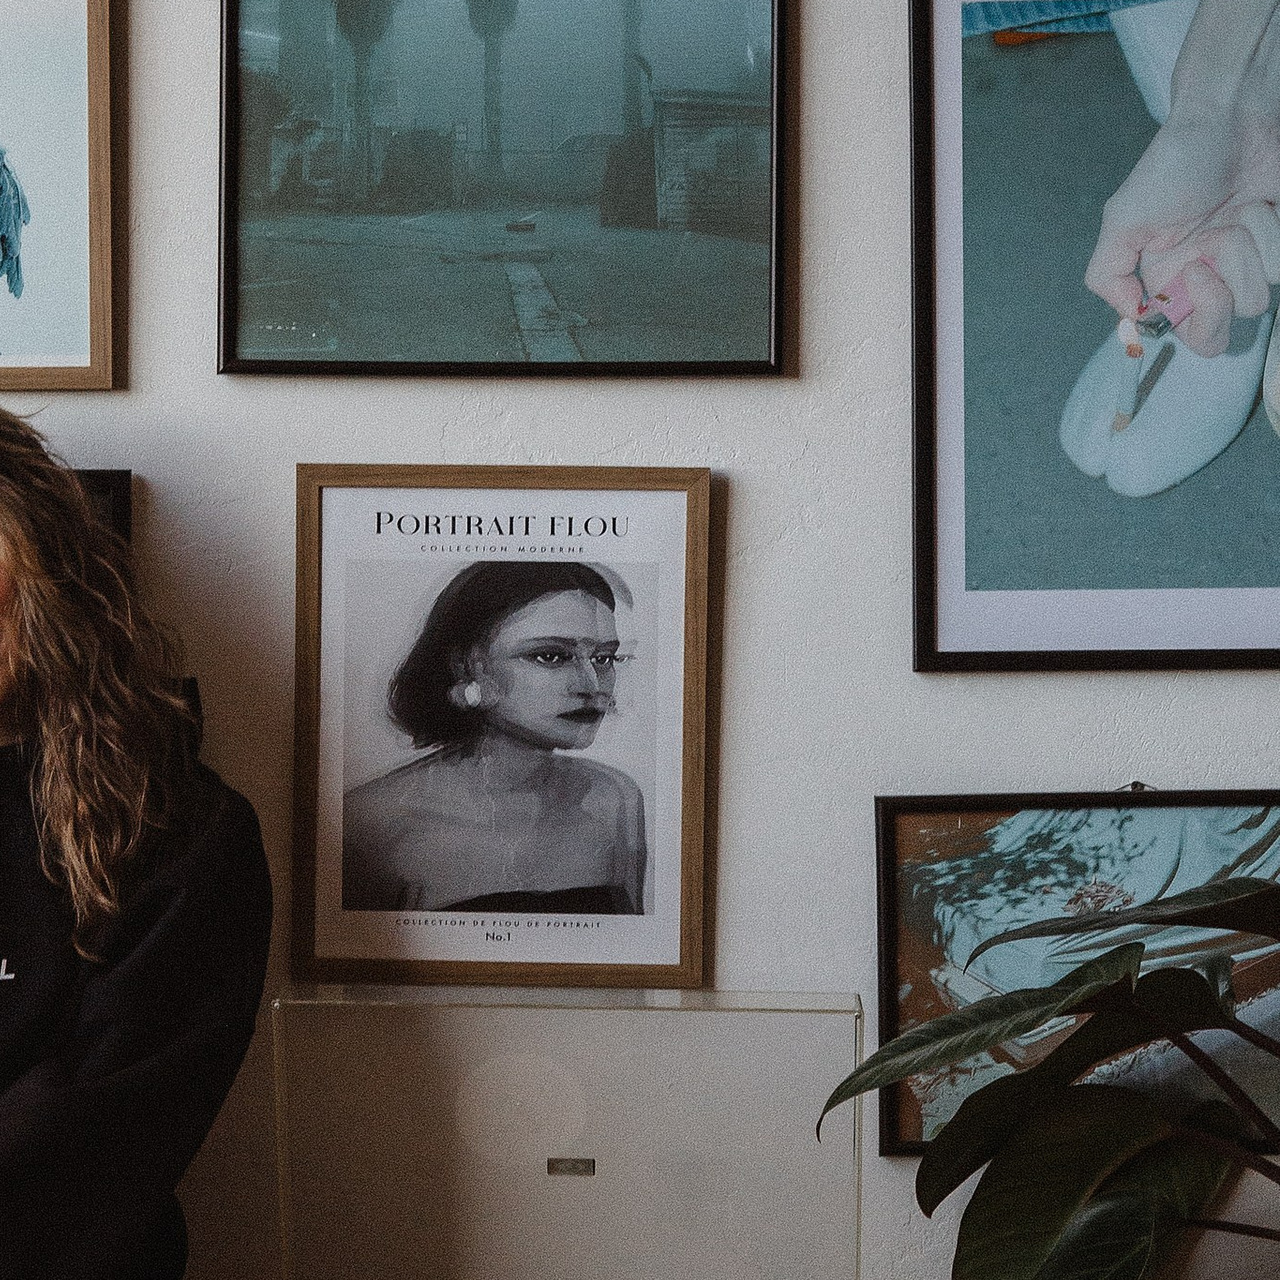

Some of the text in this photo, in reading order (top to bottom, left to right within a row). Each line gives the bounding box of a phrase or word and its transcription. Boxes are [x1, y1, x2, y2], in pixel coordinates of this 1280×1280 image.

[374, 511, 629, 537] PORTRAIT FLOU
[420, 545, 585, 553] COLLECTION MODERNE
[485, 932, 511, 942] No.1
